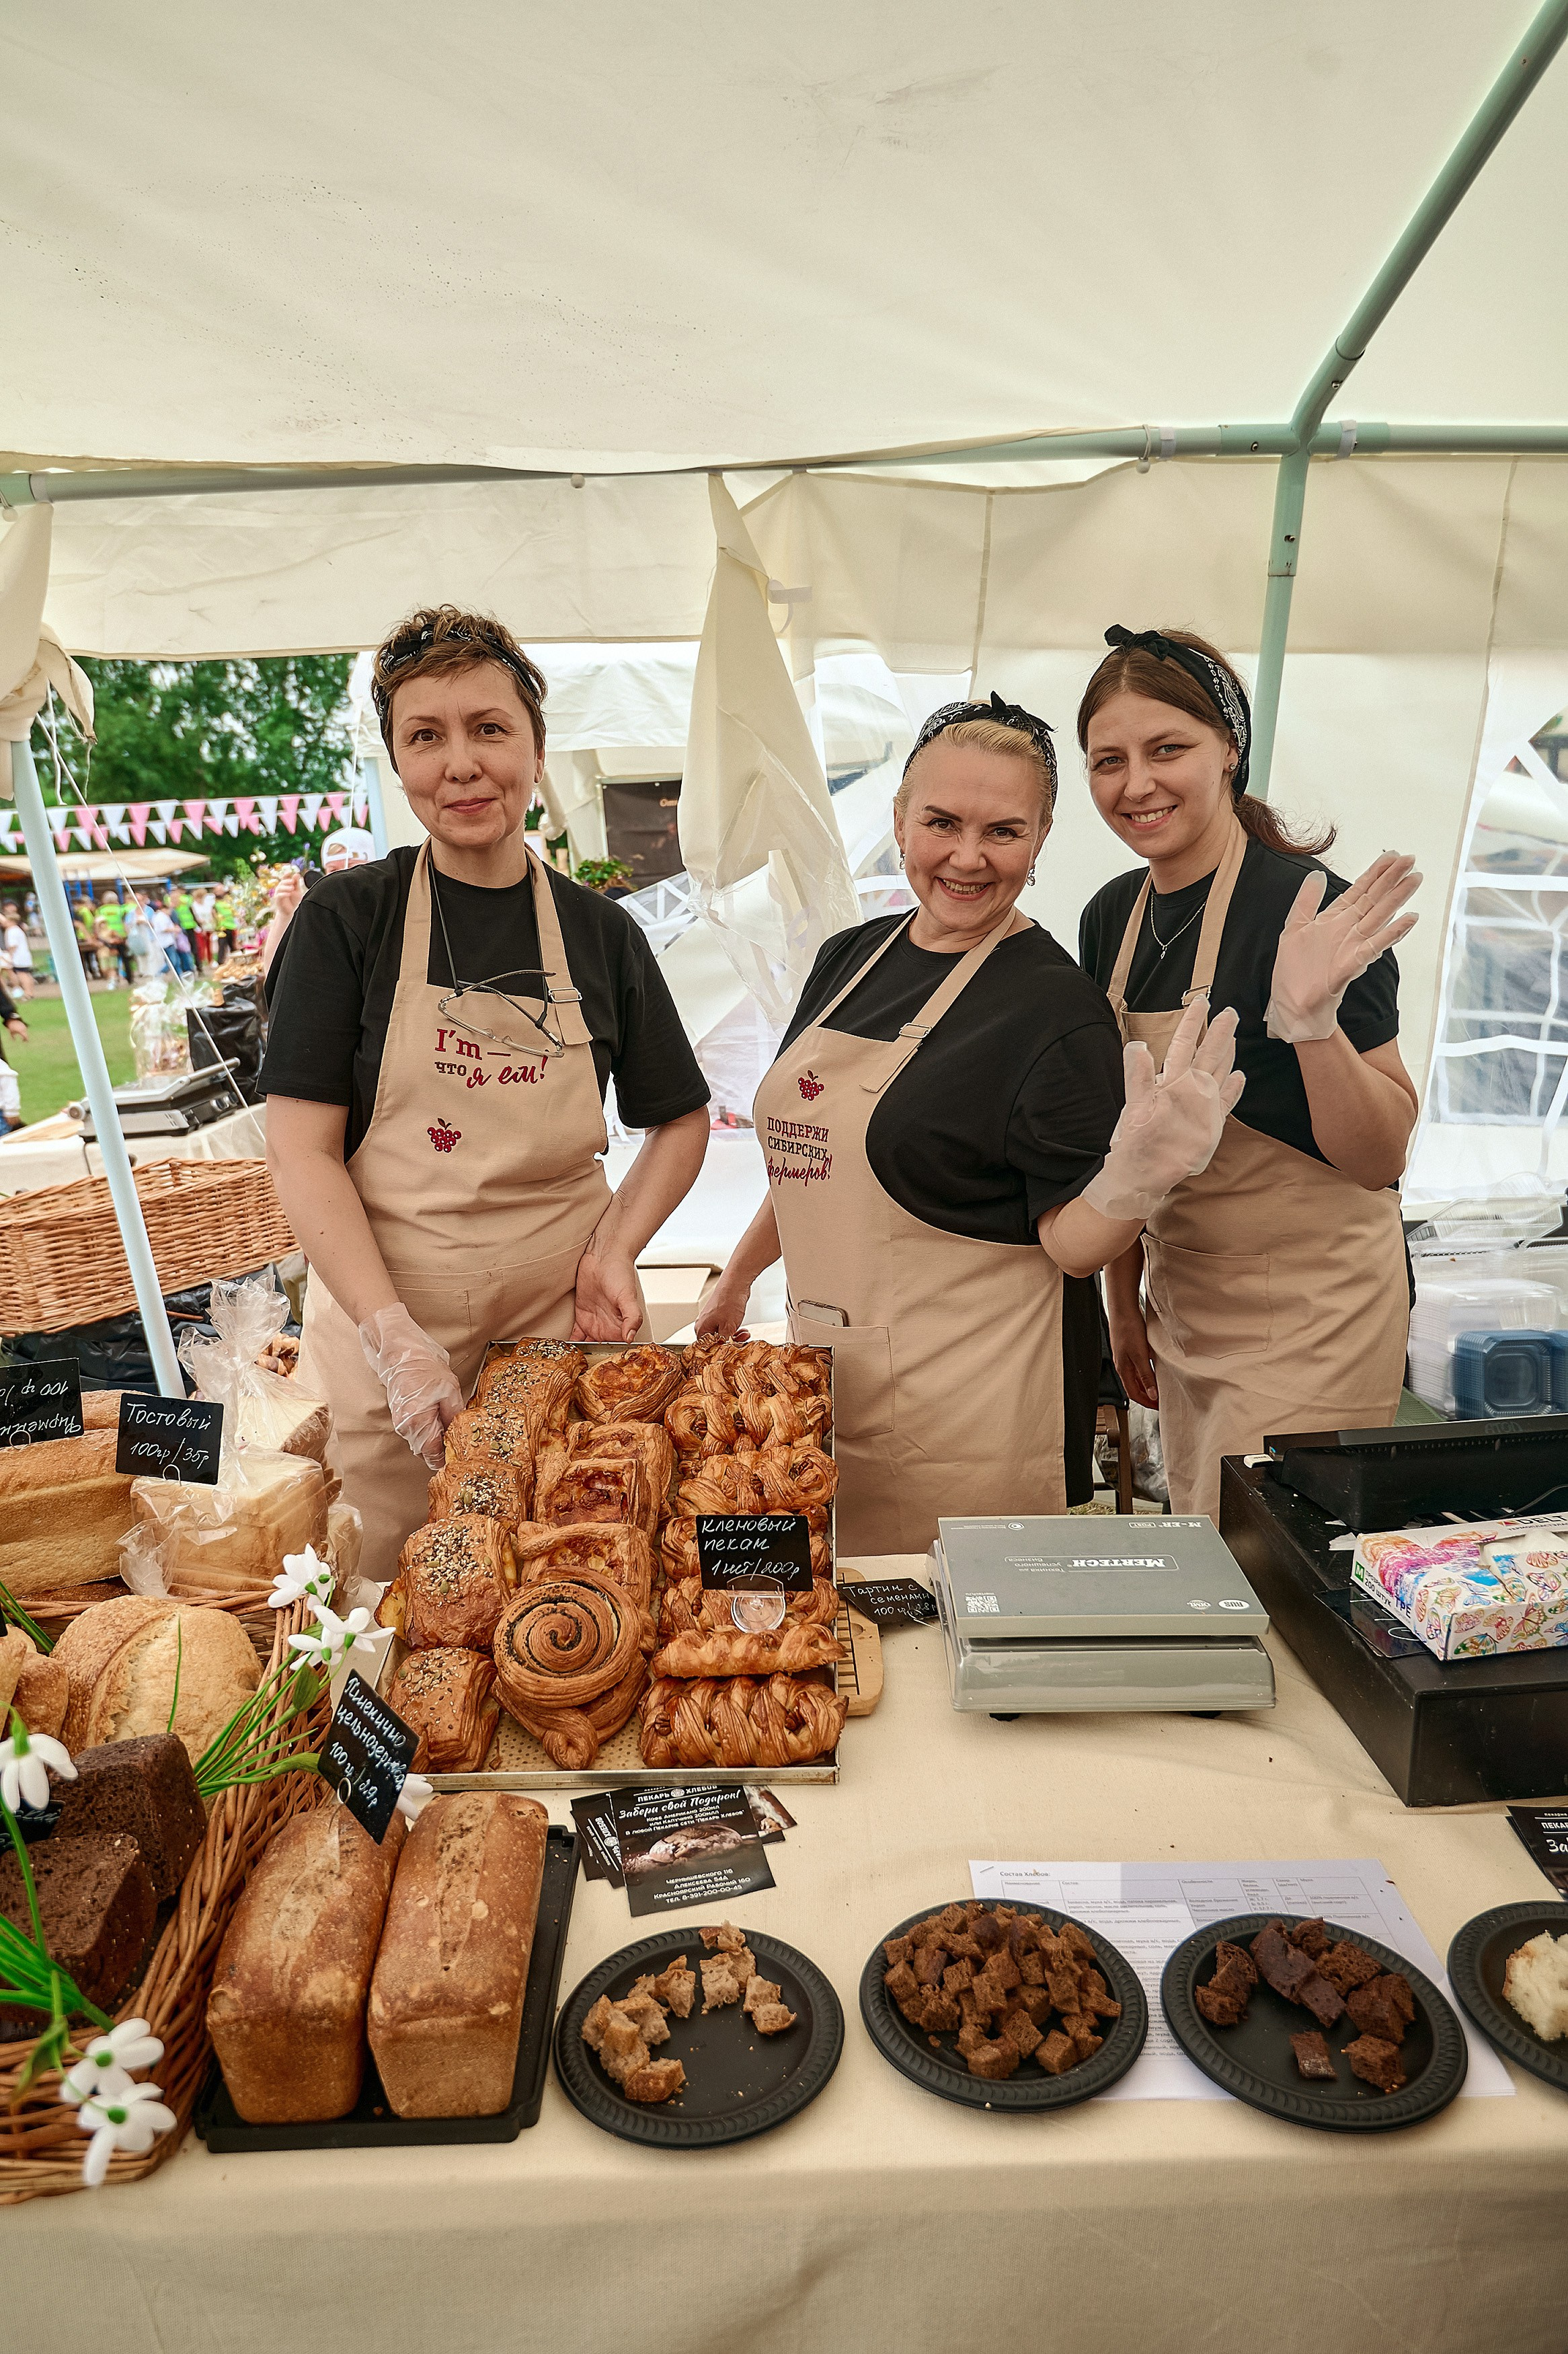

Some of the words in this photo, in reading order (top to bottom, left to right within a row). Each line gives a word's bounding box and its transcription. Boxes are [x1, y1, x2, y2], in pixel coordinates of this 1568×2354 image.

[466, 1067, 492, 1089] я
[767, 1116, 830, 1142] ПОДДЕРЖИ
[767, 1135, 828, 1161] СИБИРСКИХ
[40, 1380, 69, 1396] 100
[127, 1402, 211, 1430] Тостовый
[1365, 1578, 1375, 1592] 200
[870, 1593, 930, 1604] семенами
[874, 1606, 894, 1616] 100
[329, 1741, 348, 1766] 100
[637, 1793, 670, 1802] ПЕКАРЬ
[619, 1807, 658, 1819] Забери
[662, 1800, 687, 1811] свой
[1546, 1837, 1568, 1852] За
